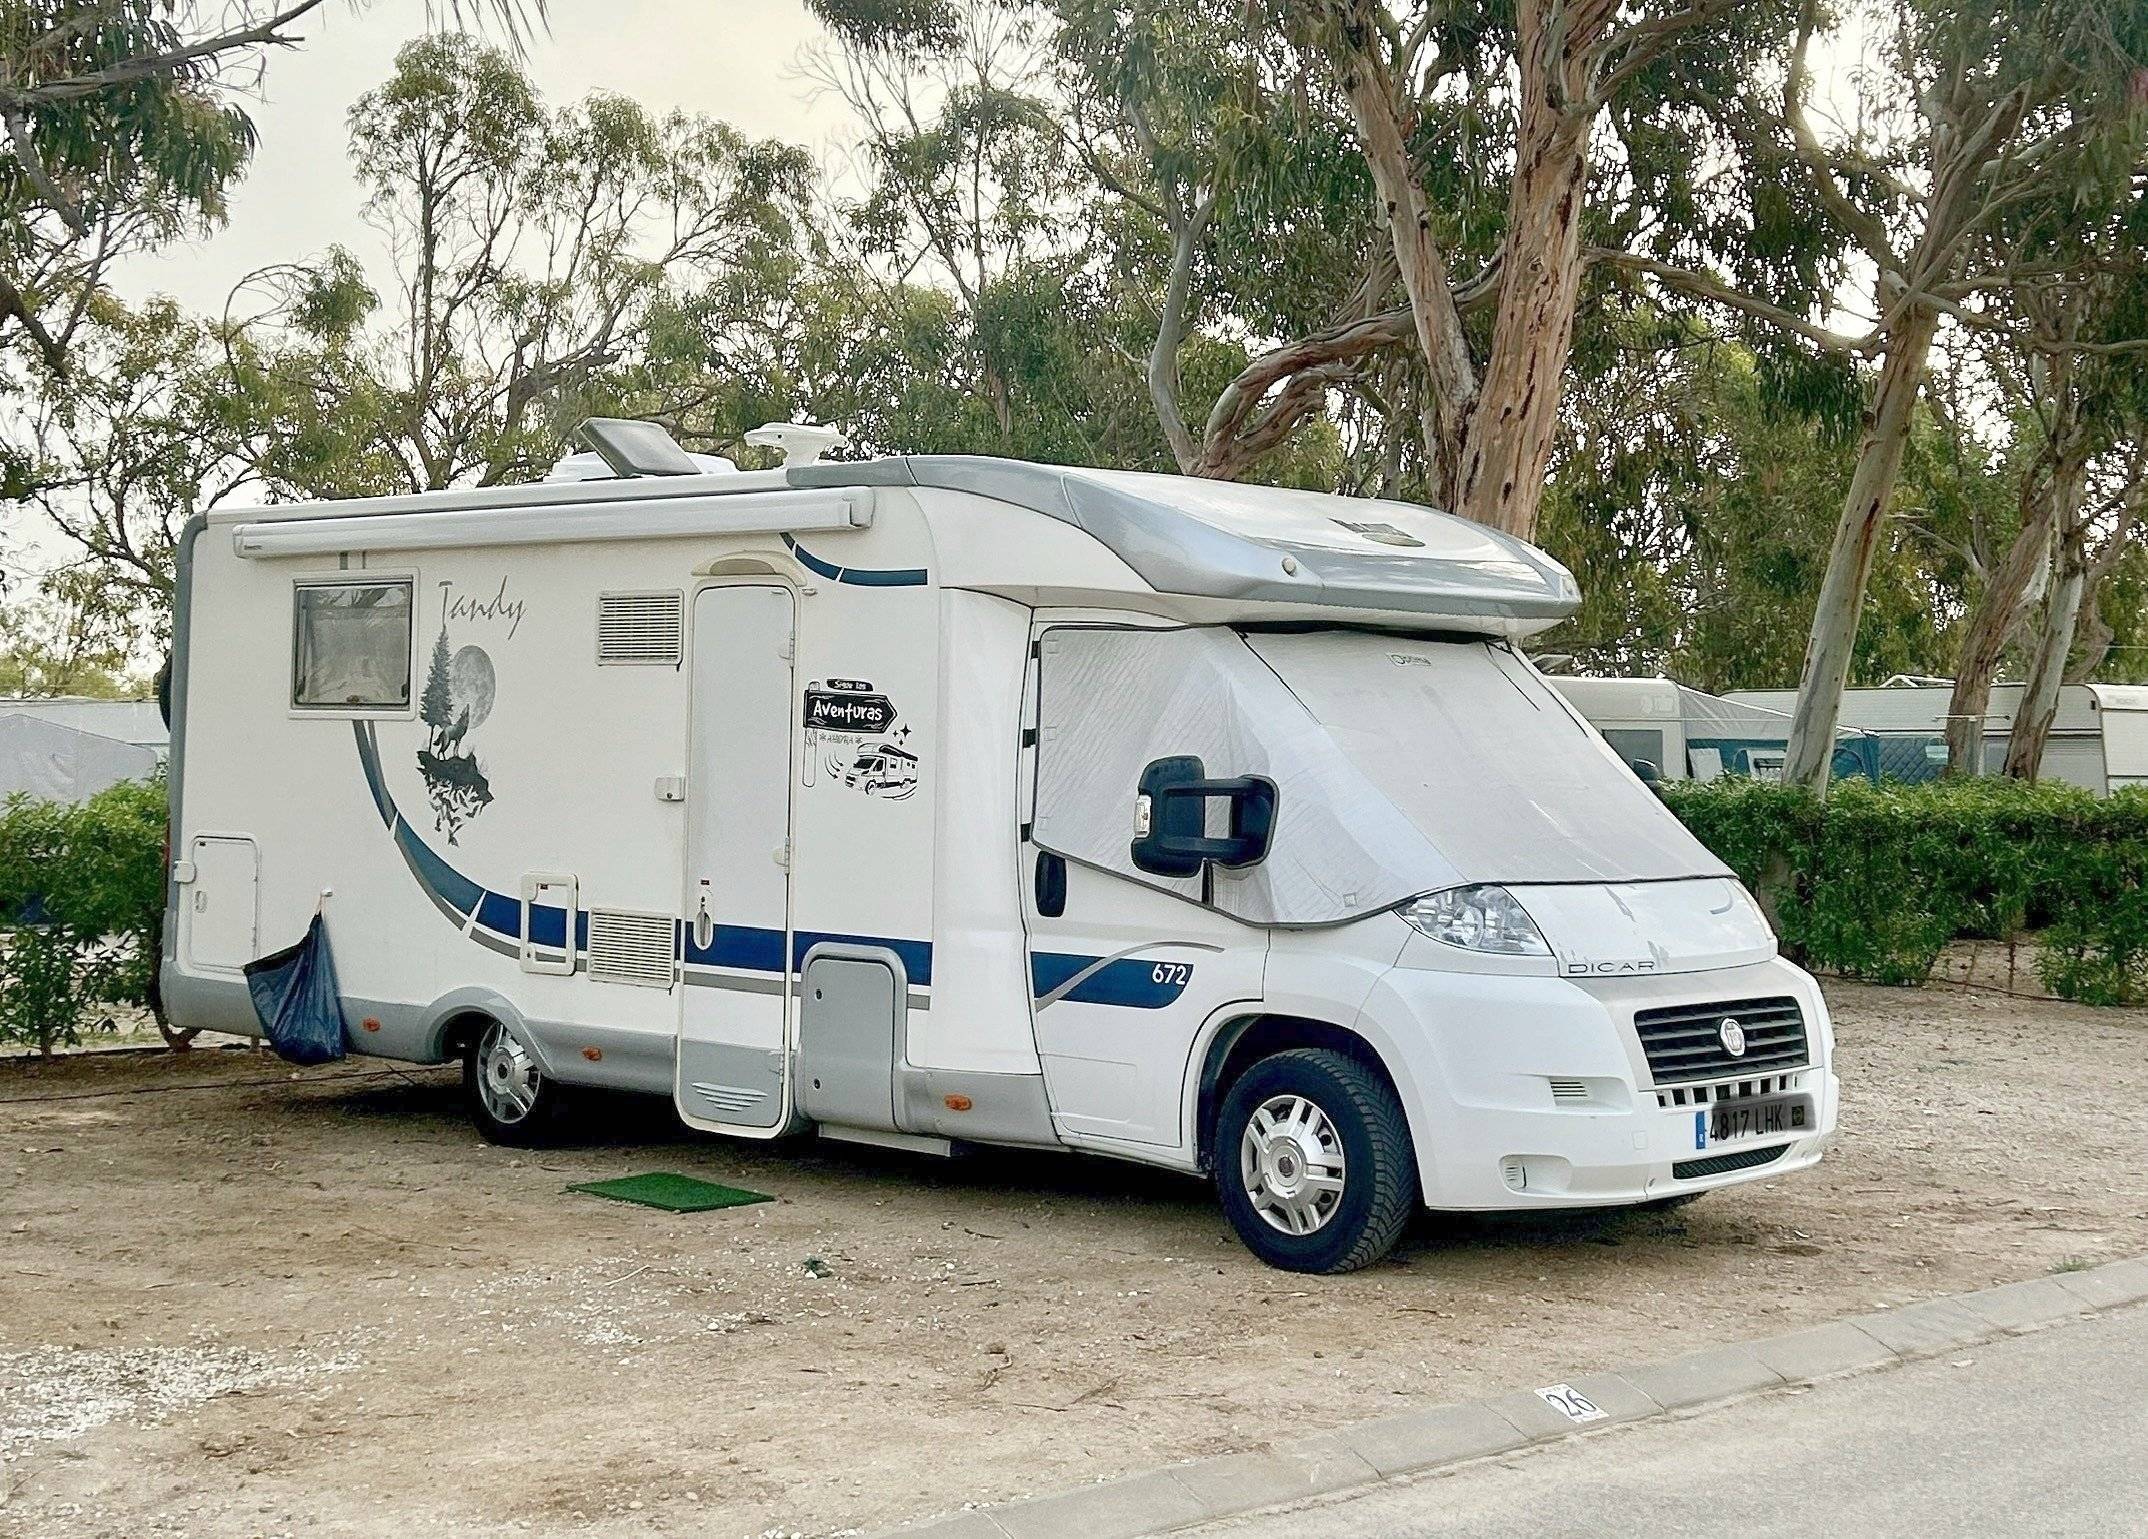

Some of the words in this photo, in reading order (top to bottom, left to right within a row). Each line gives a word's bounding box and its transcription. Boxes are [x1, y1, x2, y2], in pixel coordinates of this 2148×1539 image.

[439, 575, 527, 640] Tandy
[813, 700, 883, 723] Aventuras
[1152, 963, 1186, 985] 672
[1568, 961, 1655, 974] DICAR
[1710, 1109, 1749, 1141] 4817
[1755, 1104, 1783, 1135] LHK
[1545, 1389, 1597, 1416] 26
